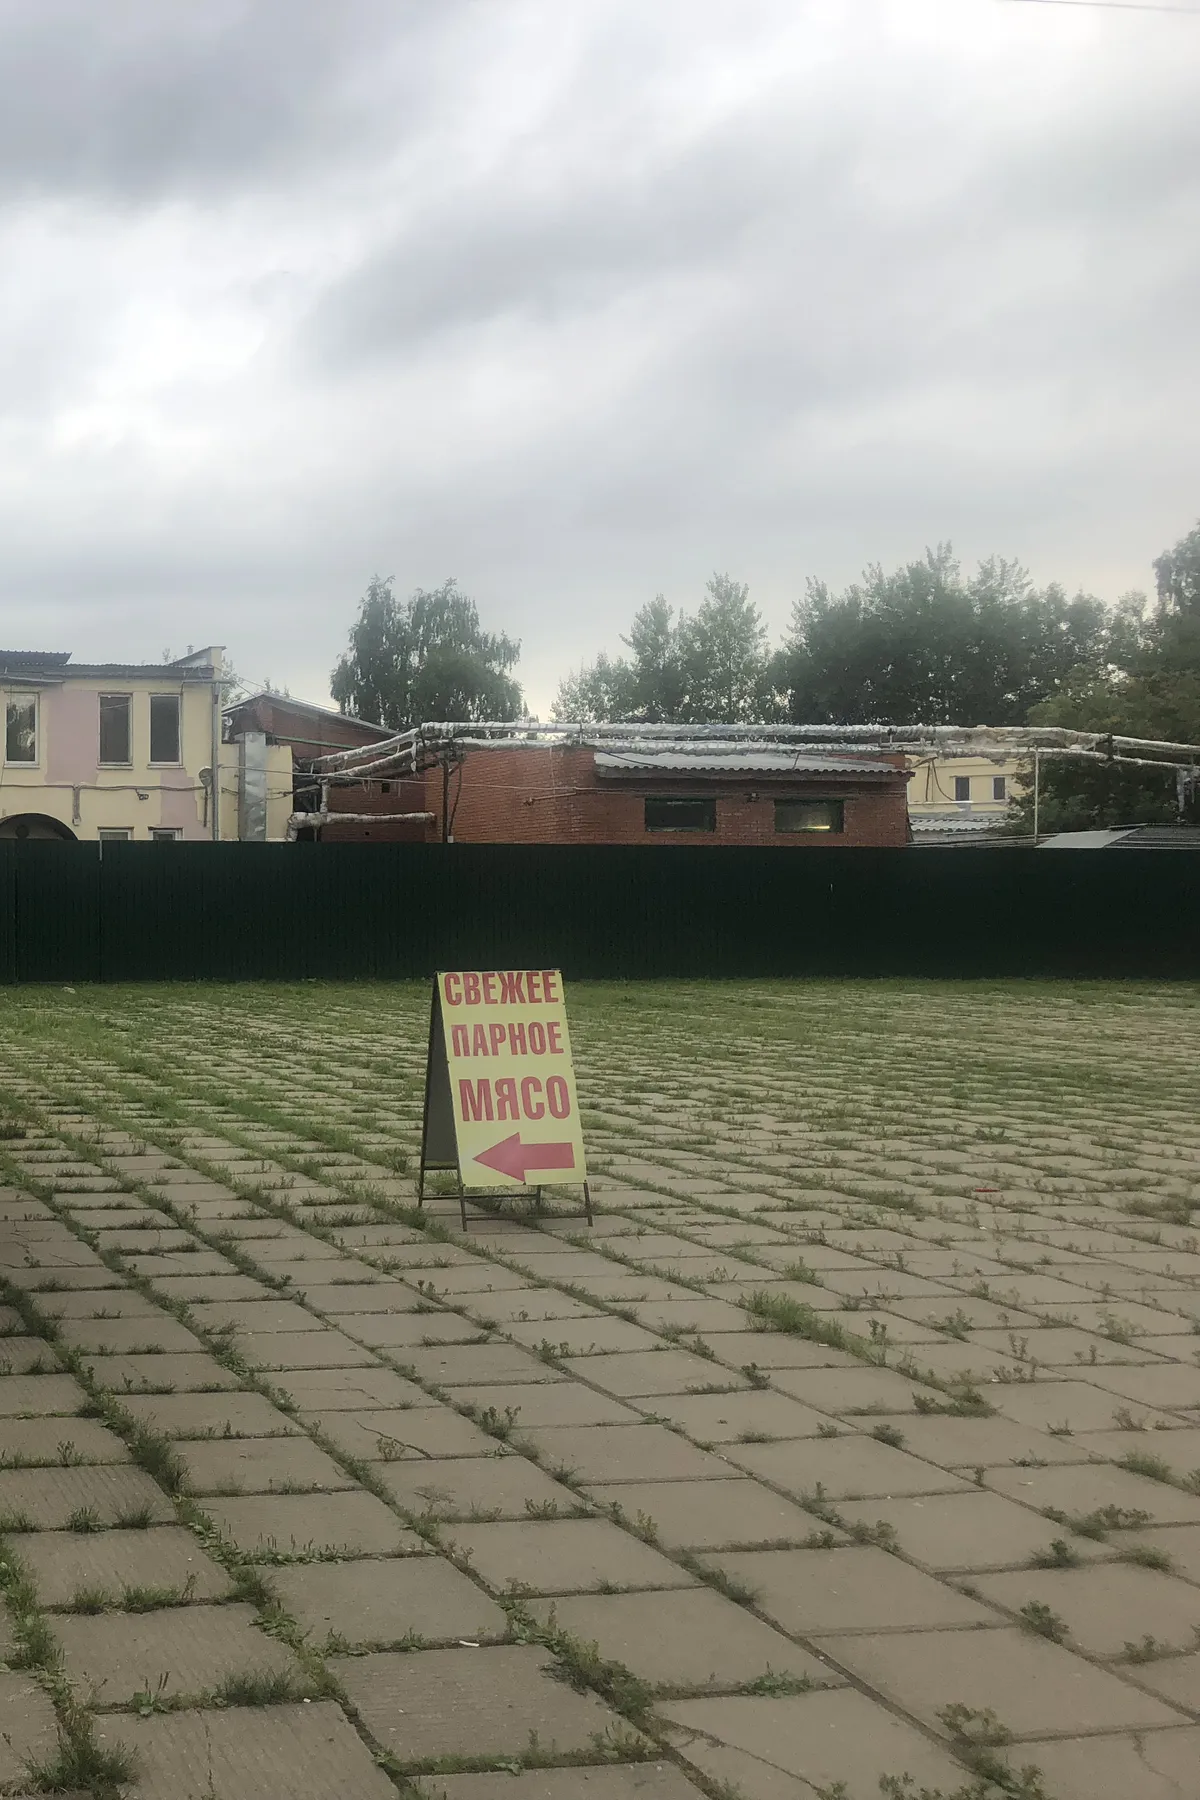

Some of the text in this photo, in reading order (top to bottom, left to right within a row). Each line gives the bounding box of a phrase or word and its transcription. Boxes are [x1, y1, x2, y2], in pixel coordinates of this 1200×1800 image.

[443, 970, 560, 1006] СВЕЖЕЕ
[451, 1021, 564, 1057] ПАРНОЕ
[458, 1075, 571, 1122] МЯСО
